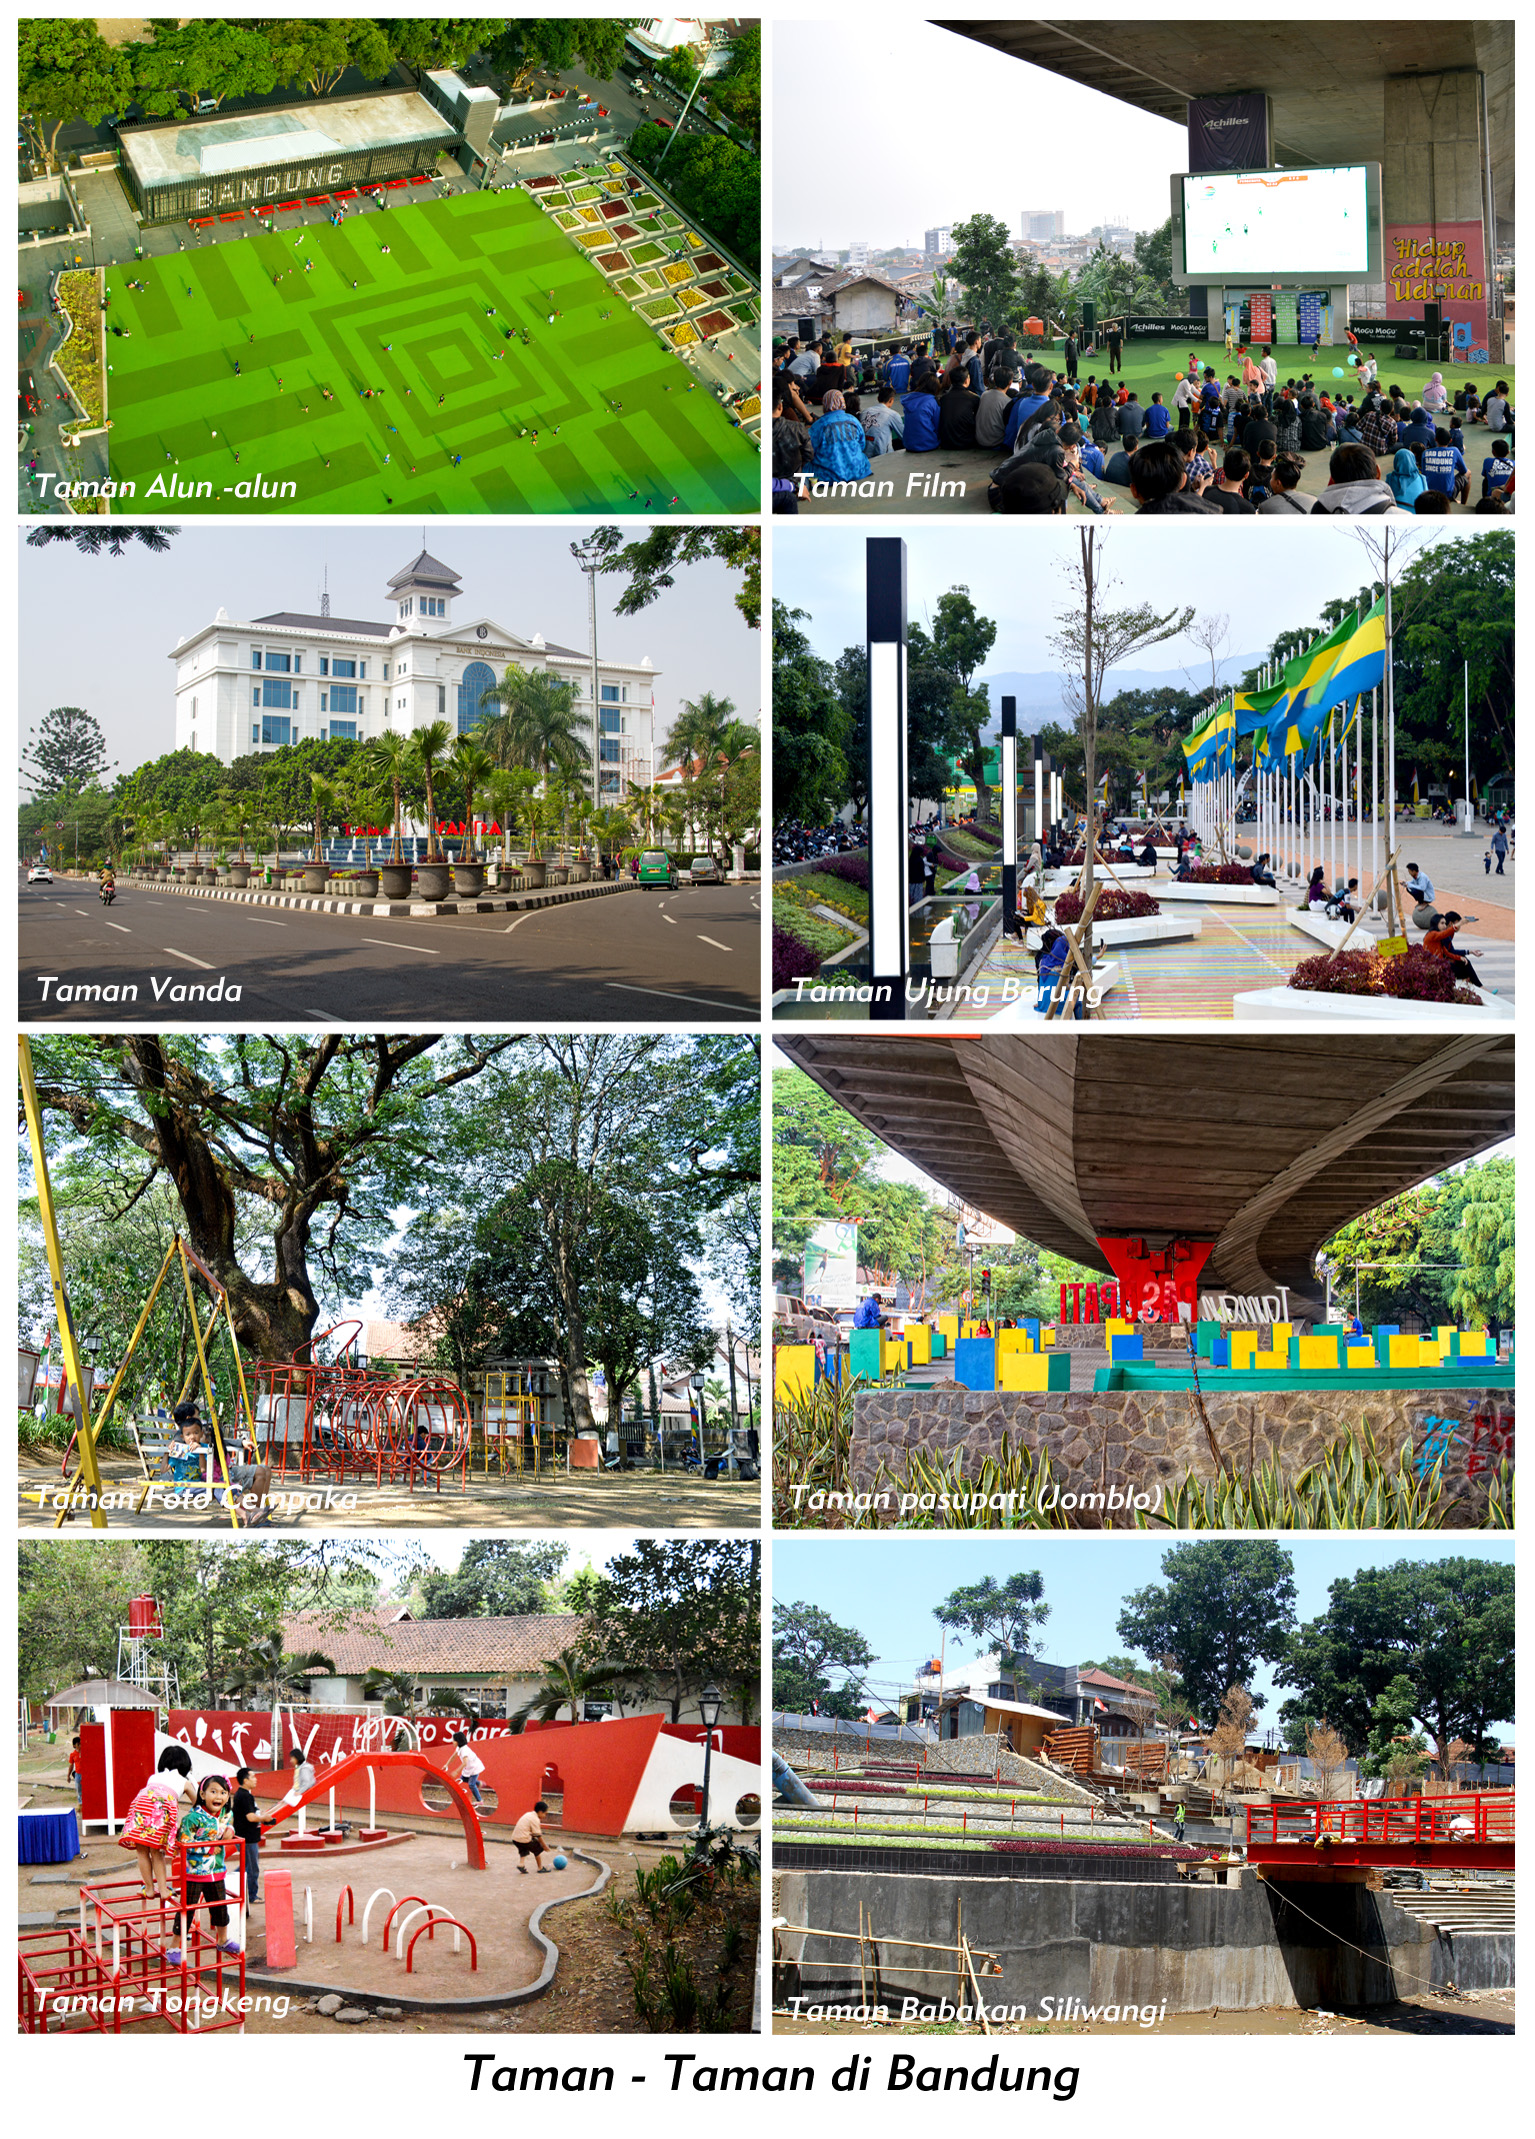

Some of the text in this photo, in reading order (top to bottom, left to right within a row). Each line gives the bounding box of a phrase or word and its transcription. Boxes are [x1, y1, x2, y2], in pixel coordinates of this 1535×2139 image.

[1203, 117, 1249, 128] Achilles
[196, 164, 343, 210] BANDUNG
[1393, 236, 1466, 261] Hidup
[1391, 254, 1473, 278] adalah
[456, 646, 506, 659] BANK INDONESIA
[342, 822, 406, 837] TAMA
[415, 1719, 436, 1742] to
[443, 1719, 511, 1743] Share
